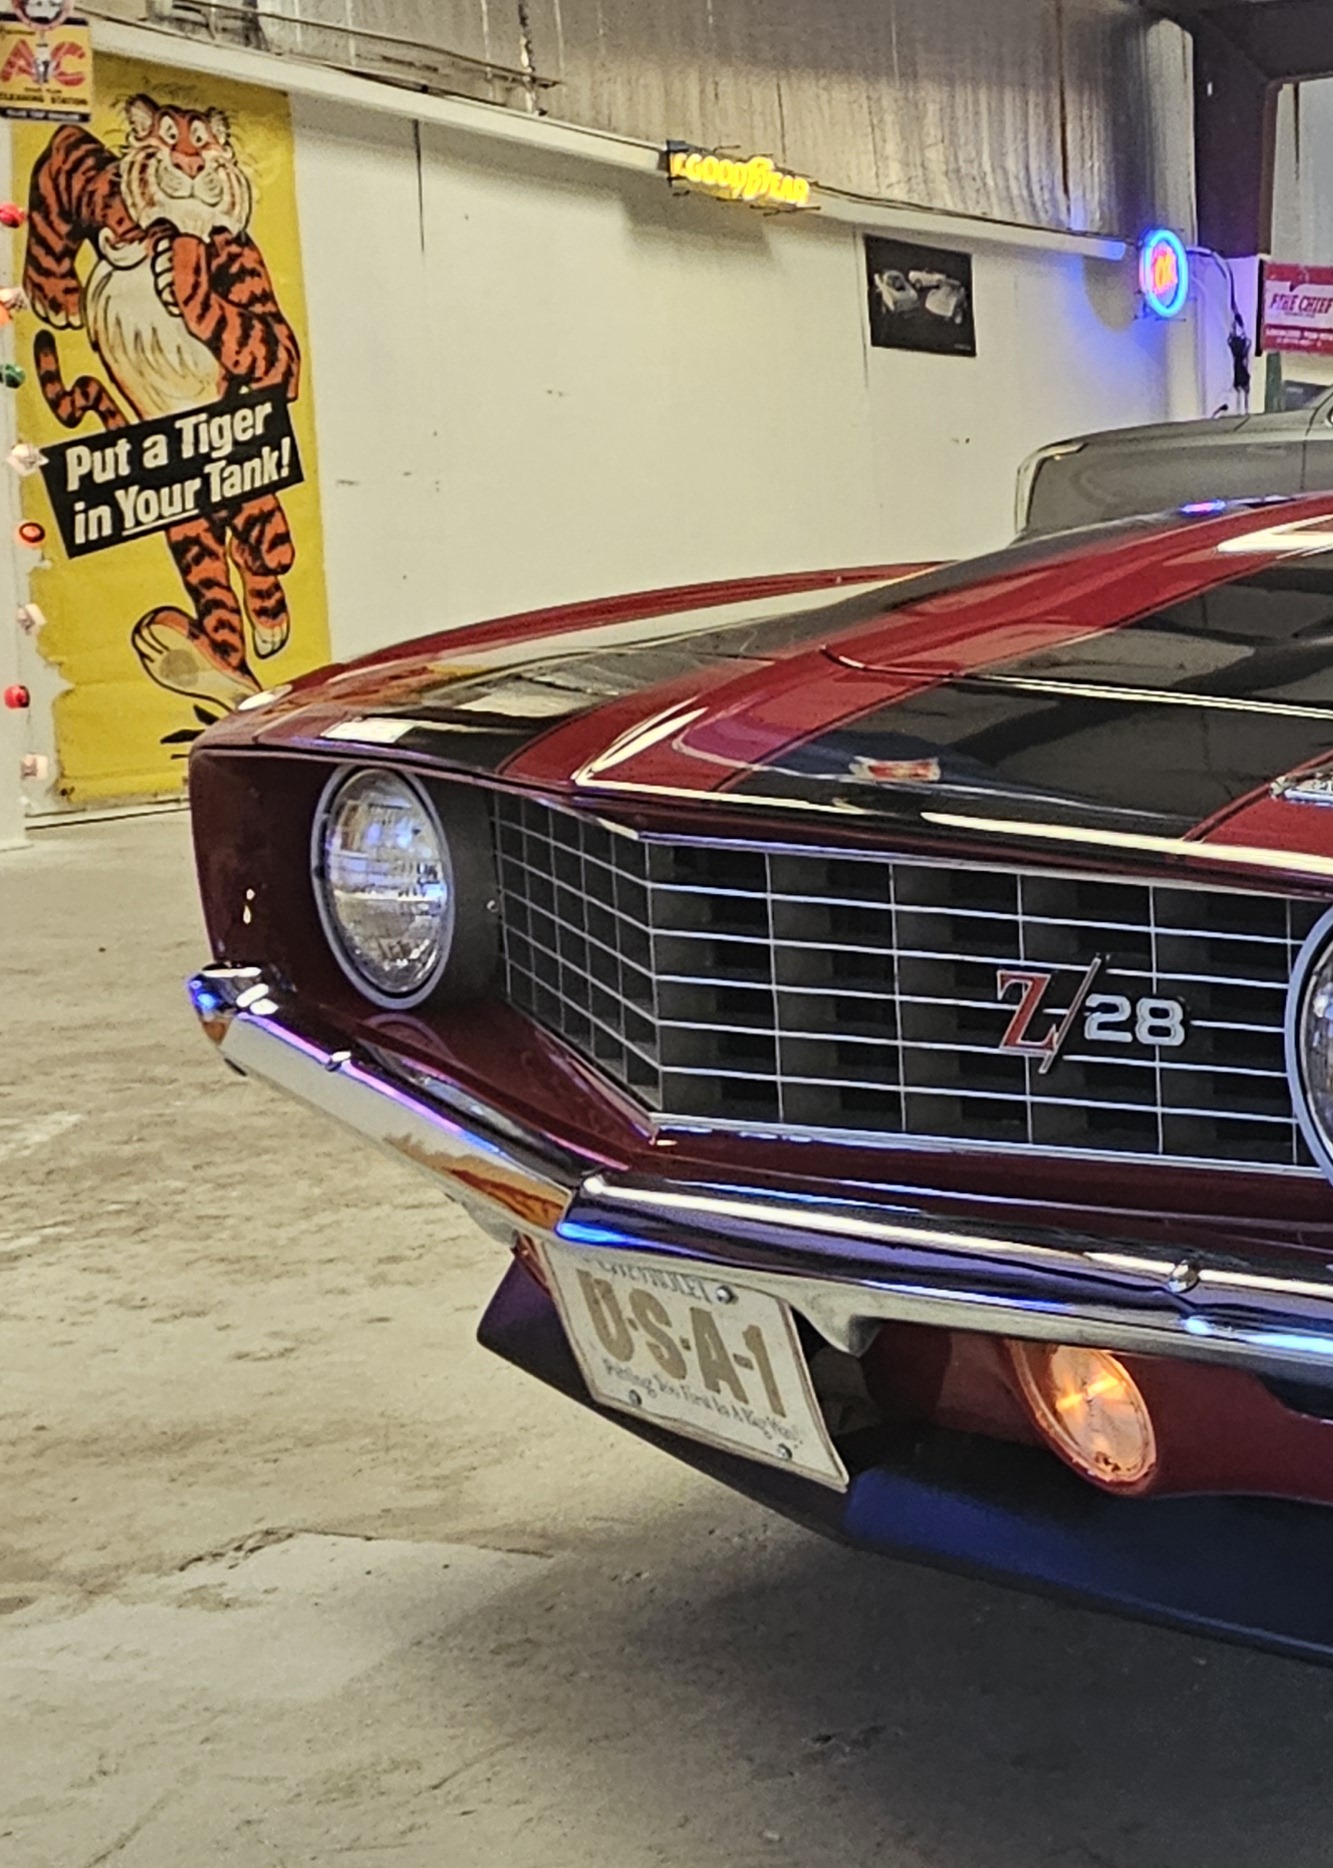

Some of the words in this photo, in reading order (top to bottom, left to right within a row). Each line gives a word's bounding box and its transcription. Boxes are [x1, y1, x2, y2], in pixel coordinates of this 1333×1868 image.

[0, 39, 86, 88] AC
[684, 153, 810, 207] GOODYEAR
[1270, 293, 1298, 311] FIRE
[65, 438, 132, 492] Put
[142, 434, 168, 468] a
[174, 402, 273, 459] Tiger
[73, 501, 112, 545] in
[114, 477, 202, 530] Your
[203, 436, 292, 503] Tank!
[996, 957, 1186, 1075] Z/28
